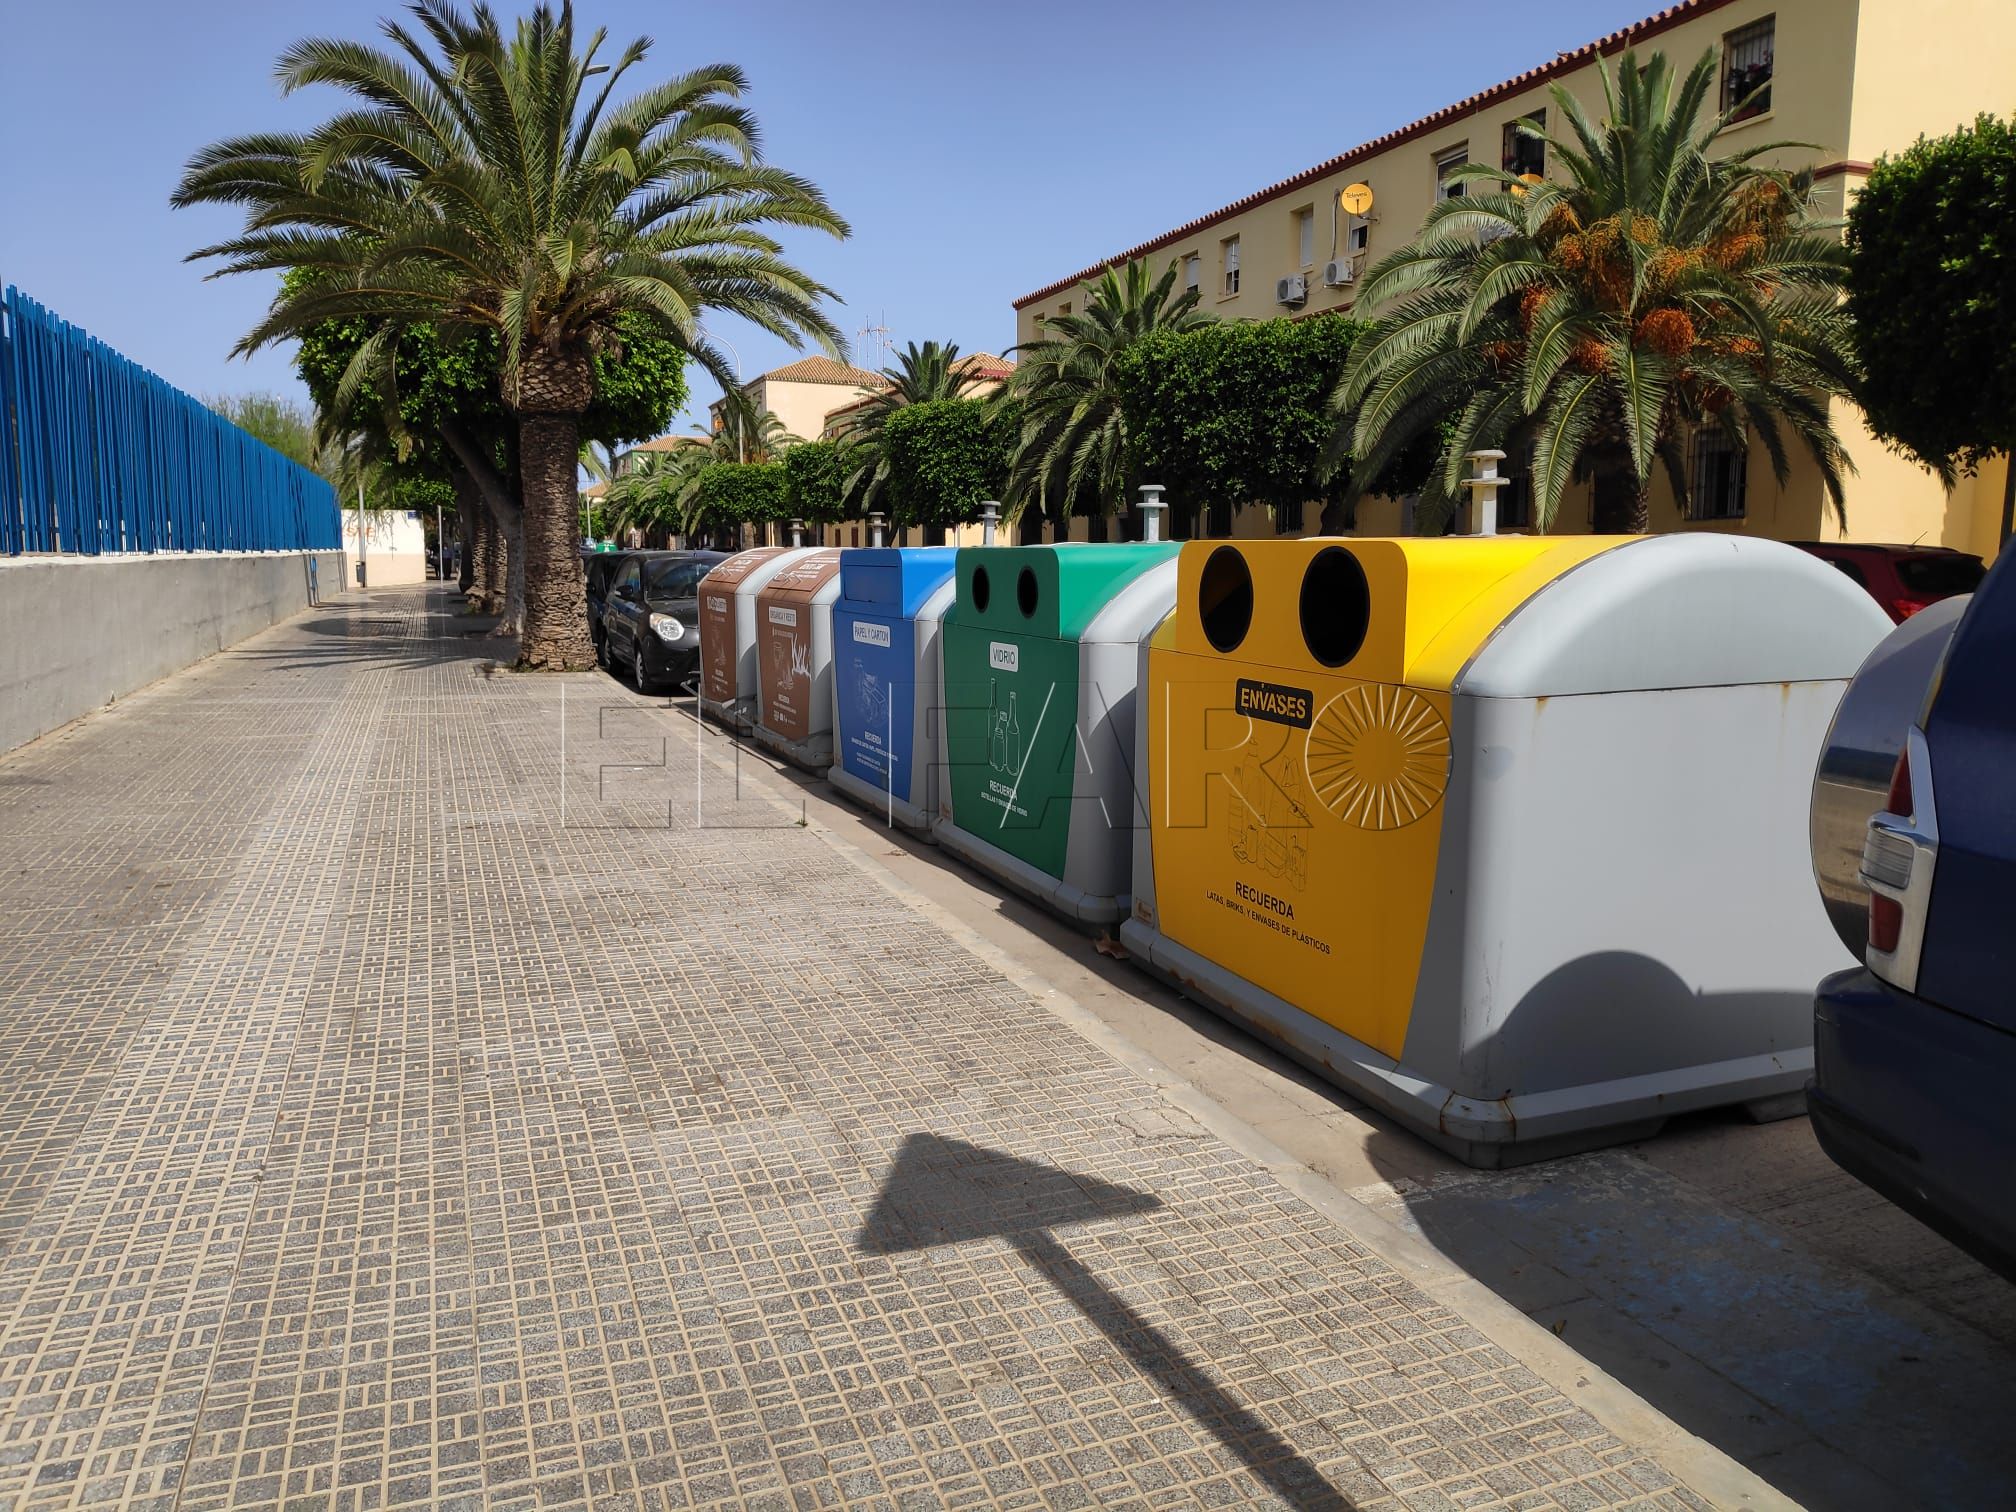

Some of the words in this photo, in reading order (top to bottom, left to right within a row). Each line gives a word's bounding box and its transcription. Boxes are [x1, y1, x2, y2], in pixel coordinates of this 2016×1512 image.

[854, 626, 867, 639] PAPEL
[992, 647, 1016, 665] VIDRIO
[1240, 687, 1306, 719] ENVASES
[989, 780, 1018, 801] RECUERDA
[1234, 881, 1295, 921] RECUERDA
[1246, 908, 1252, 918] Y
[1251, 910, 1281, 932] ENVASES
[1281, 925, 1291, 937] DE
